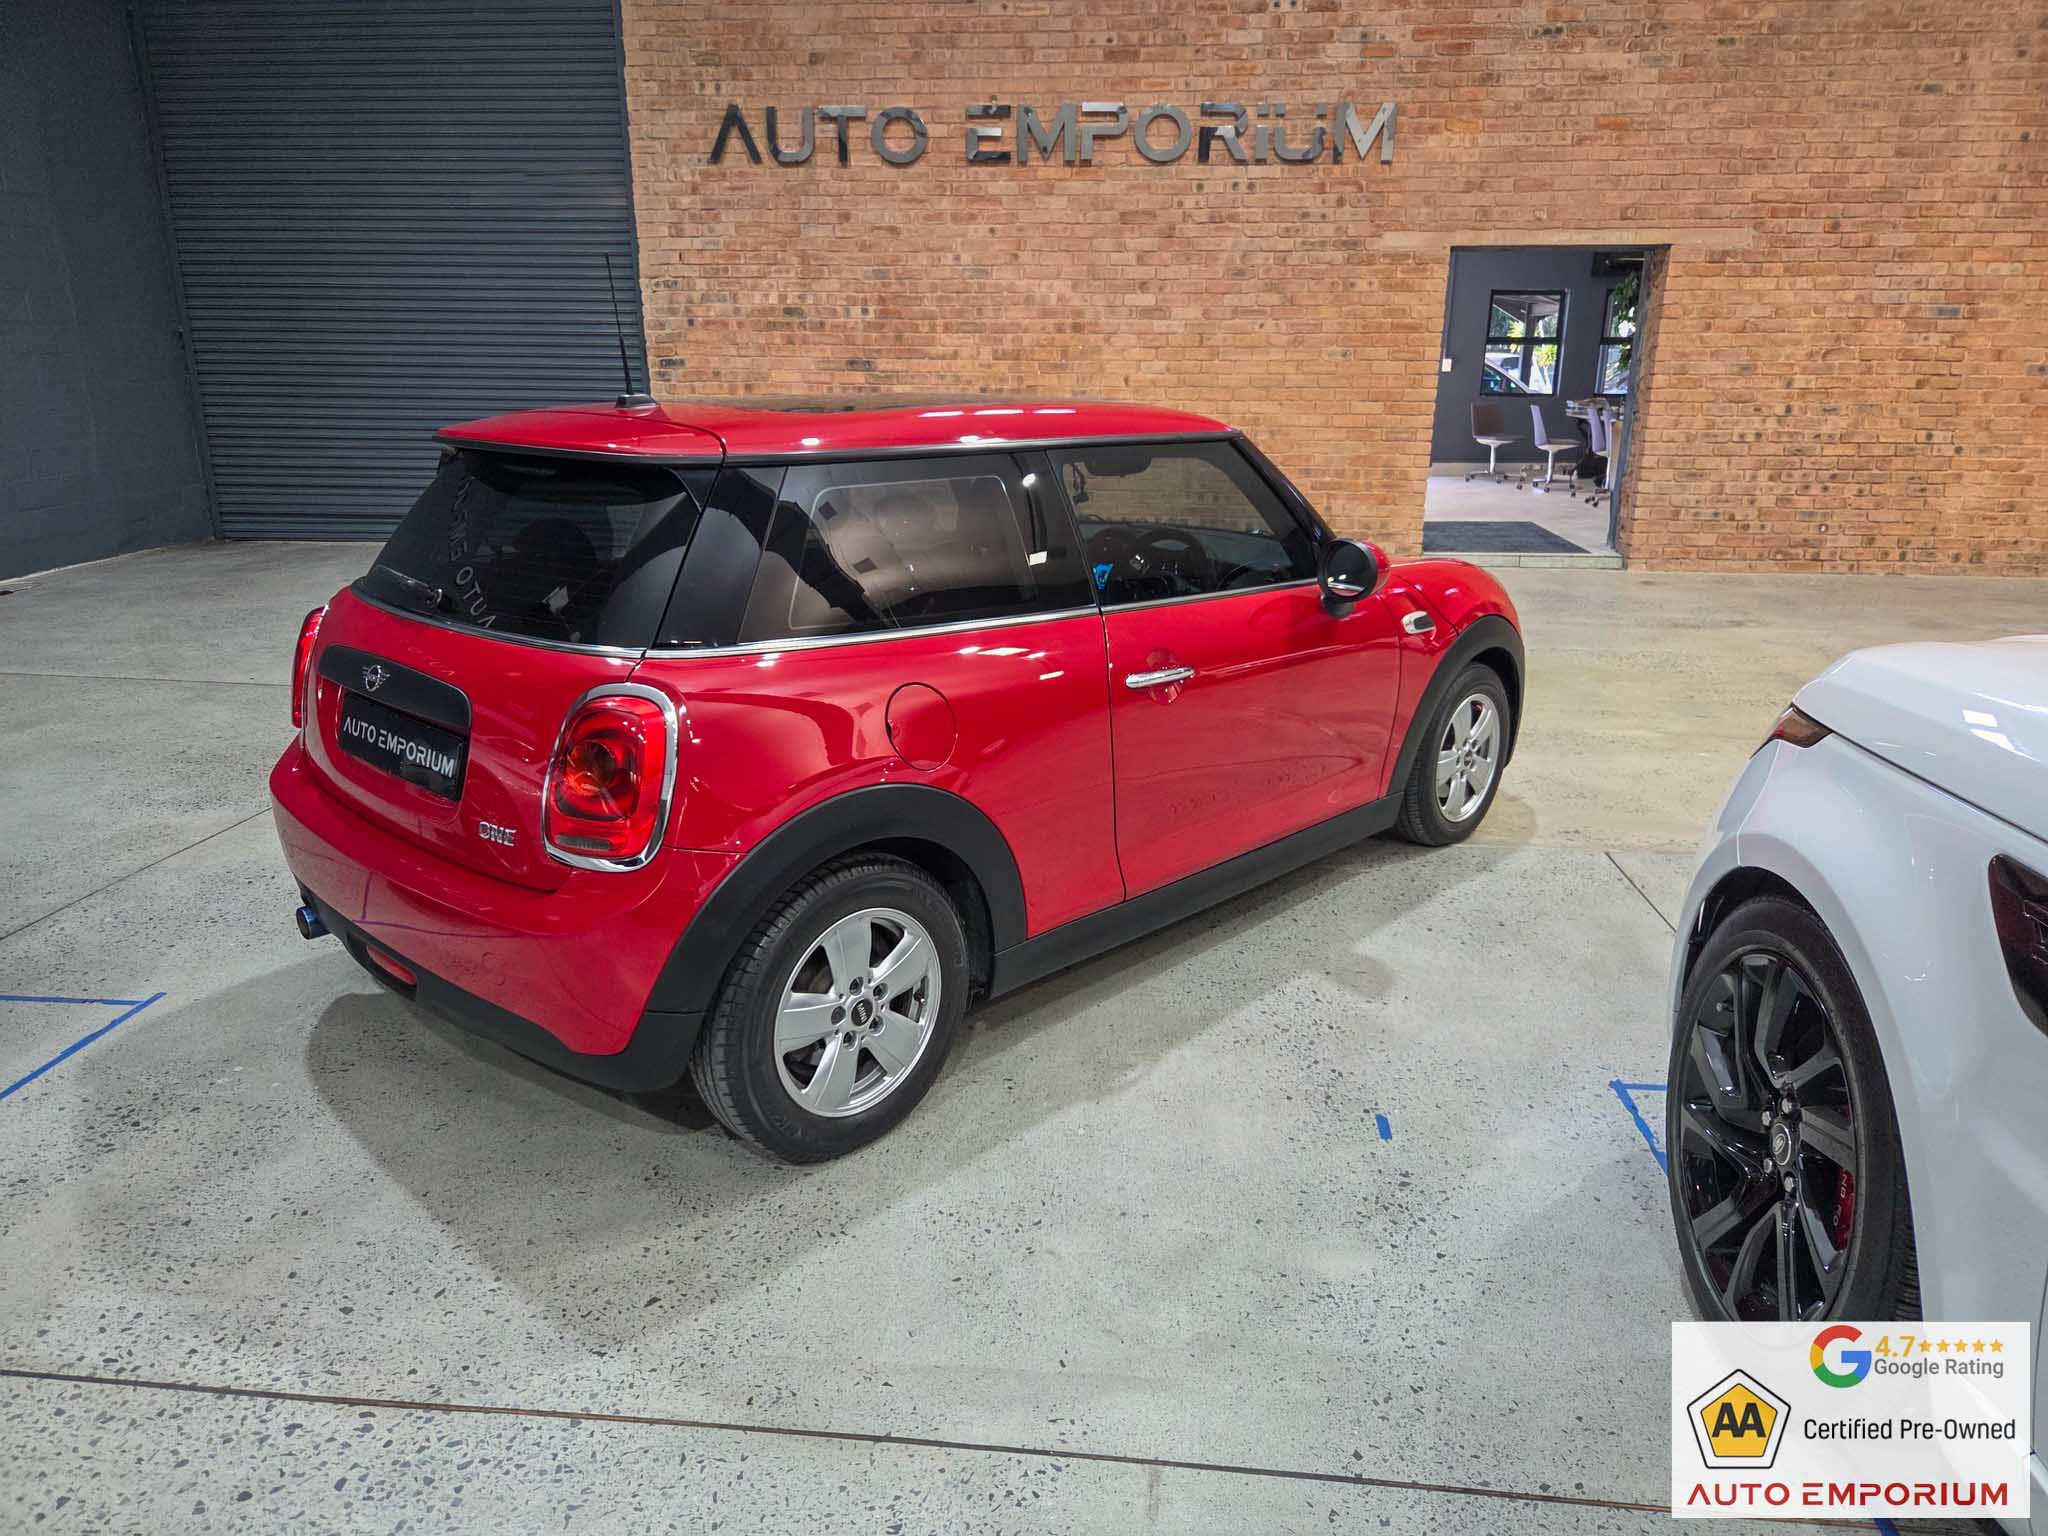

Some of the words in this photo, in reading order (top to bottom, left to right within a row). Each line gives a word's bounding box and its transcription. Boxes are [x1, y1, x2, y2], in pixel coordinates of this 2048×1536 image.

[708, 103, 928, 165] AUTO
[966, 102, 1397, 164] EMPORIUM
[343, 716, 377, 743] AUTO
[377, 729, 455, 778] EMPORIUM
[479, 821, 517, 847] ONE
